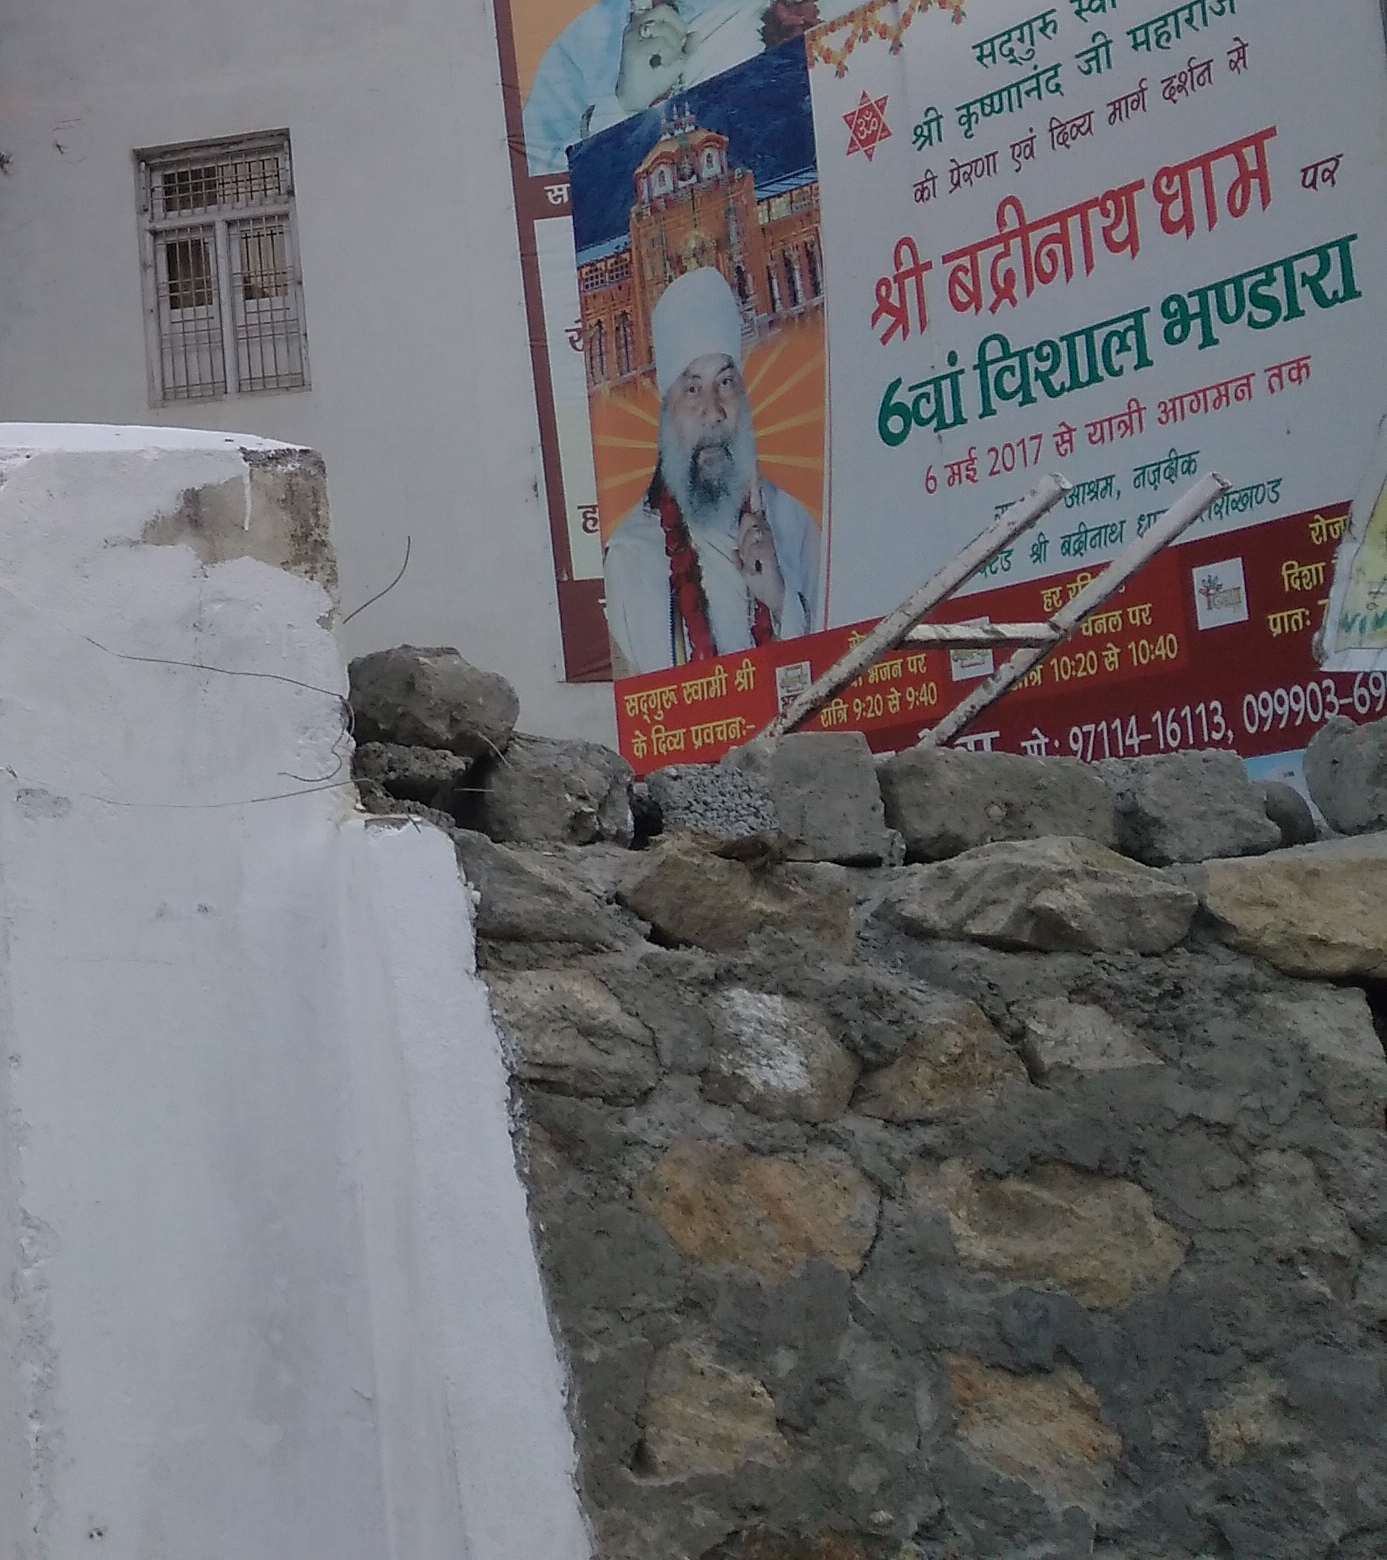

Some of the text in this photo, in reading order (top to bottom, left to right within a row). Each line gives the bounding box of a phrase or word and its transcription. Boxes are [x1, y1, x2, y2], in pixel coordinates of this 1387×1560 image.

[972, 8, 1057, 68] सद्गुरु
[911, 107, 944, 151] श्री
[956, 63, 1064, 140] कृष्णानंद
[1075, 31, 1113, 75] जी
[855, 110, 879, 140] ॐ
[913, 37, 1249, 204] की प्रेरणा एवं दिव्य मार्ग दर्शन से
[870, 125, 1344, 346] श्री बद्रीनाथ धाम पर
[878, 233, 1363, 447] 6वां विशाल भण्डारा
[924, 355, 1312, 495] 6 मई 2017 से यात्री आगमन तक
[1030, 532, 1050, 564] श्री
[1060, 518, 1126, 559] बद्रीनाथ
[1040, 587, 1064, 612] हर
[1282, 560, 1326, 592] दिशा
[1128, 603, 1153, 626] पर
[1268, 608, 1311, 638] प्रातः
[868, 657, 903, 687] भजन
[906, 653, 927, 674] पर
[1050, 651, 1098, 682] 10:20
[1102, 643, 1121, 672] से
[1128, 634, 1178, 667] 10:40
[624, 658, 755, 724] सद्गुरू स्वामी श्री
[820, 698, 849, 728] रात्रि
[852, 694, 883, 723] 9:20
[888, 687, 902, 713] से
[906, 681, 938, 710] 9:40
[1243, 671, 1387, 734] 099903-69
[632, 730, 647, 759] के
[651, 724, 685, 756] दिव्य
